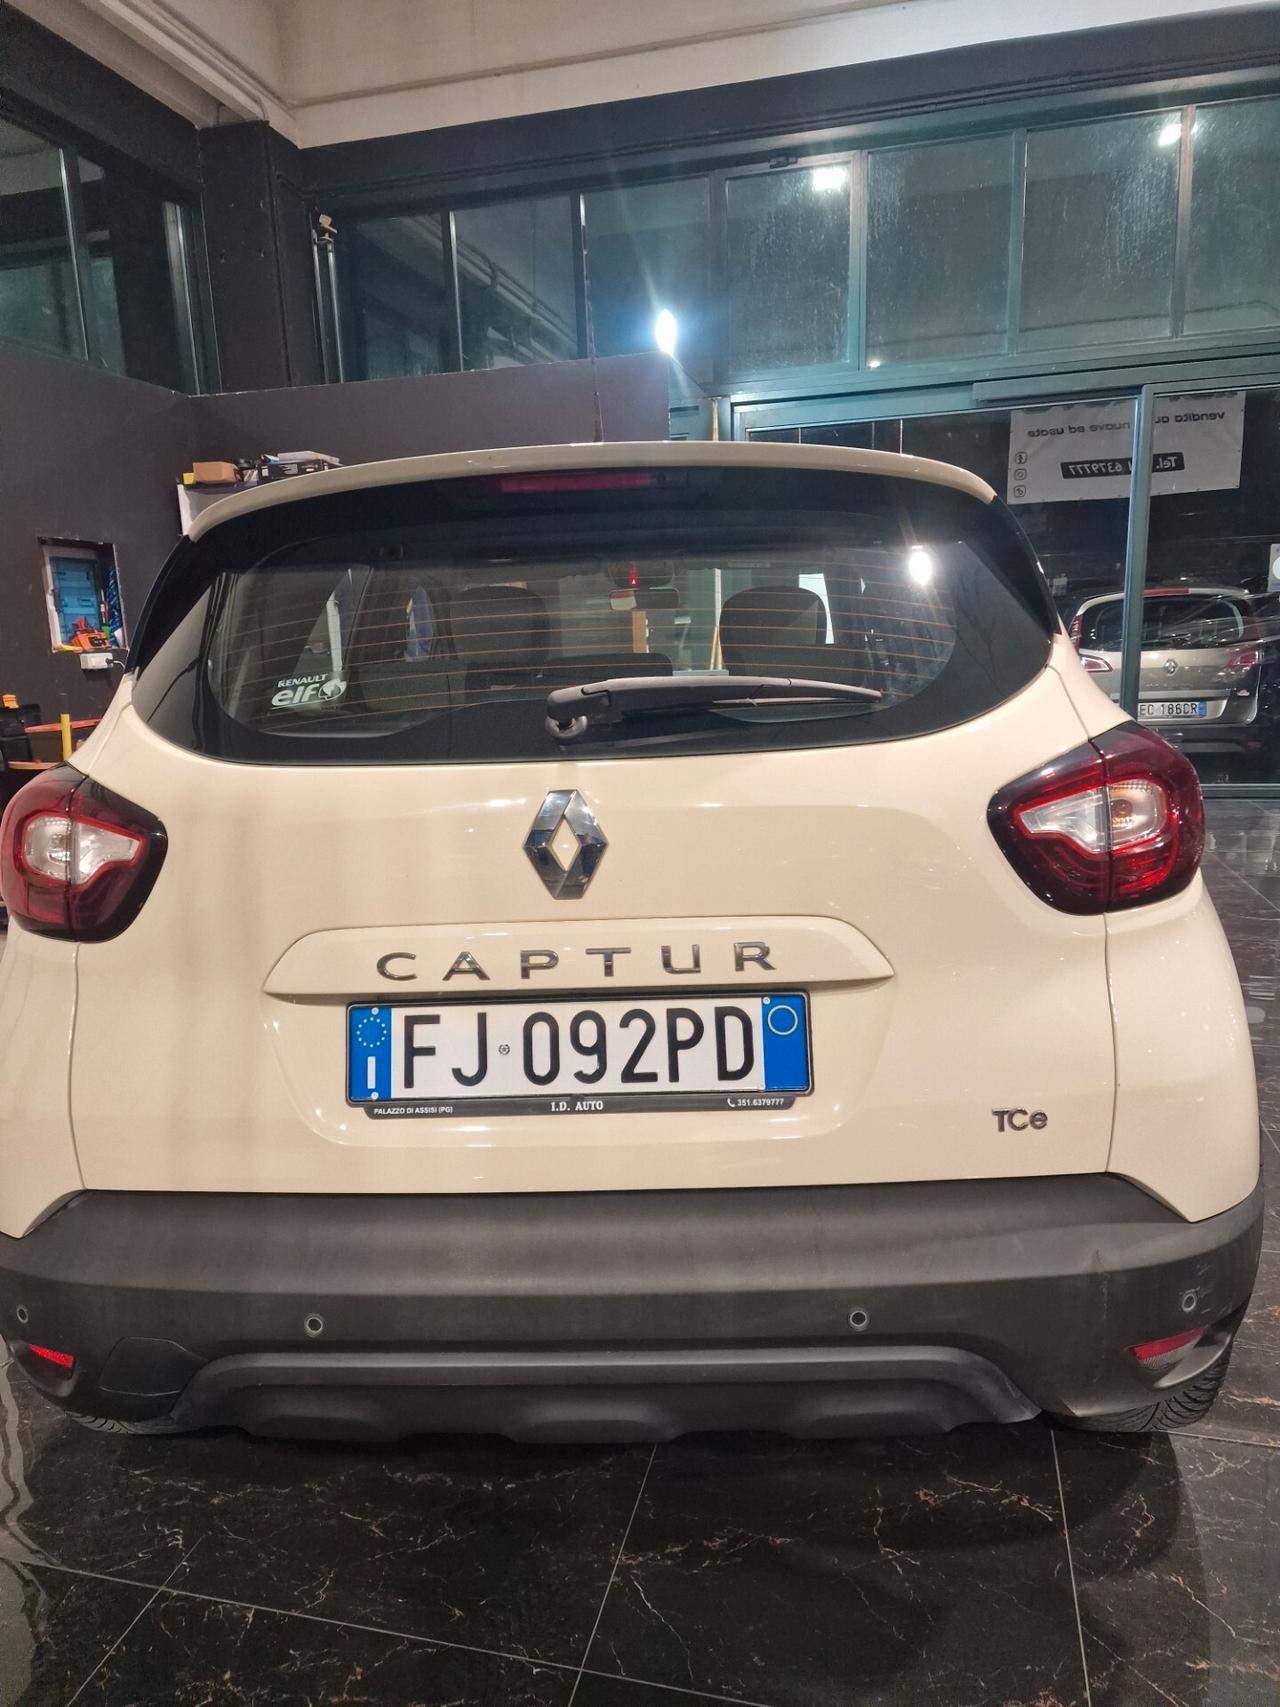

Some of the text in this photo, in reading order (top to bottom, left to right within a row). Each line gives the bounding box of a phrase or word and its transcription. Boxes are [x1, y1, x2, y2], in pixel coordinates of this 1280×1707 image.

[277, 674, 329, 688] RENAULT
[271, 683, 320, 706] elf
[376, 941, 777, 981] CAPTUR
[373, 1106, 453, 1115] PALAZZO DI ASSISI (PG)
[551, 1100, 604, 1112] I.D. AUTO
[992, 1109, 1048, 1132] TCe
